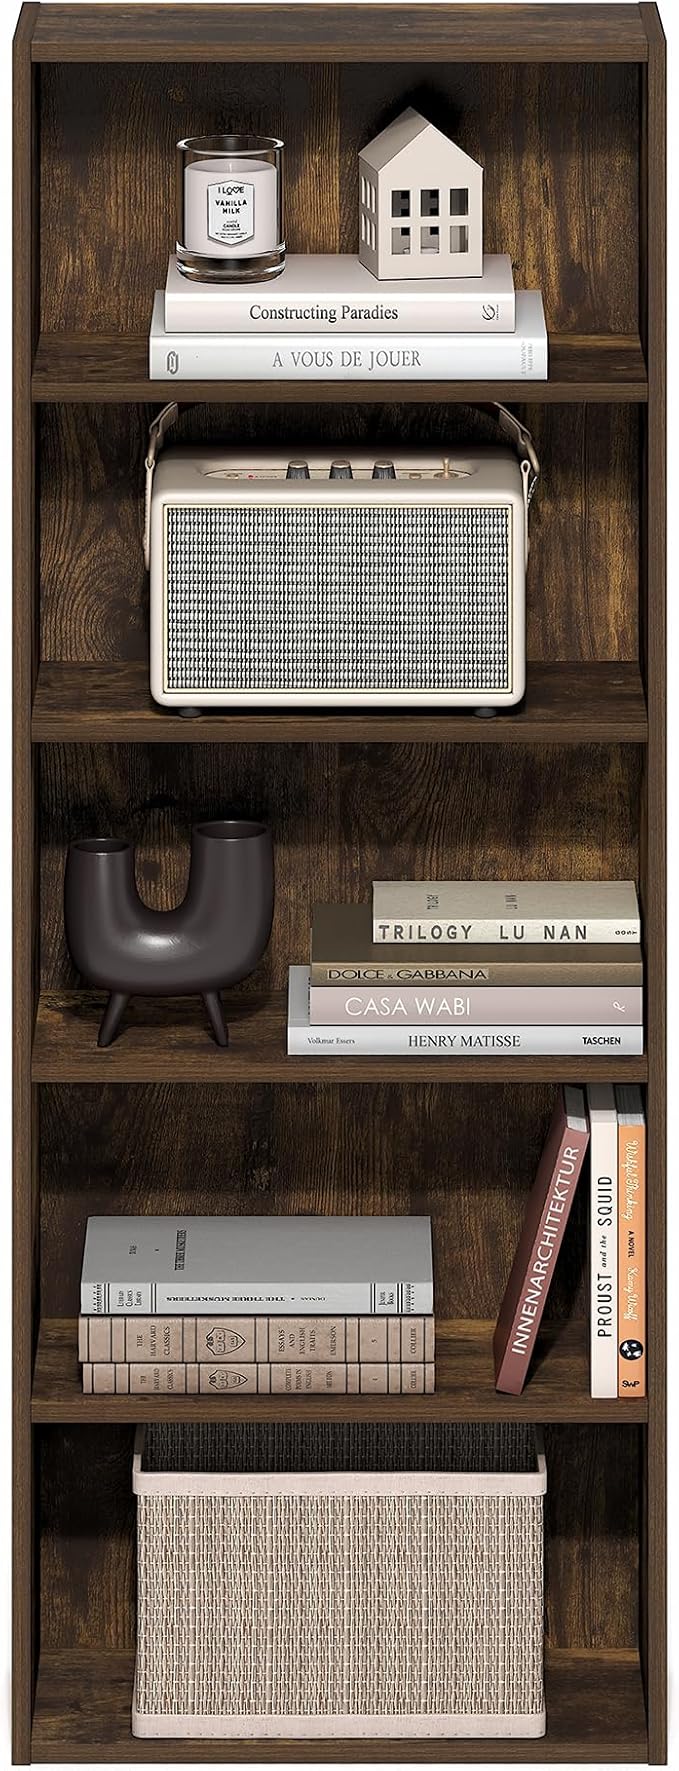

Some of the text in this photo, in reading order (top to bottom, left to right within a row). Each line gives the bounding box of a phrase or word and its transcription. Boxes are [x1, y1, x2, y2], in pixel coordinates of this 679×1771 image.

[215, 199, 248, 207] VANILLA
[249, 304, 399, 323] Constructing Paradies
[272, 351, 422, 371] A VOUS DE JOUER
[378, 924, 588, 940] TRILOGY LU NAN
[328, 969, 385, 980] DOLCE
[396, 969, 487, 980] GABBANA
[345, 997, 470, 1016] CASA WABI
[408, 1035, 521, 1048] HENRY MATISSE
[582, 1036, 622, 1046] TASCHEN
[511, 1145, 580, 1355] INNENARCHITEKTUR
[596, 1176, 613, 1338] PROUST and the SQUID
[149, 1325, 157, 1357] HARVARD
[163, 1326, 171, 1356] CLASSICS
[329, 1326, 337, 1356] EMERSON
